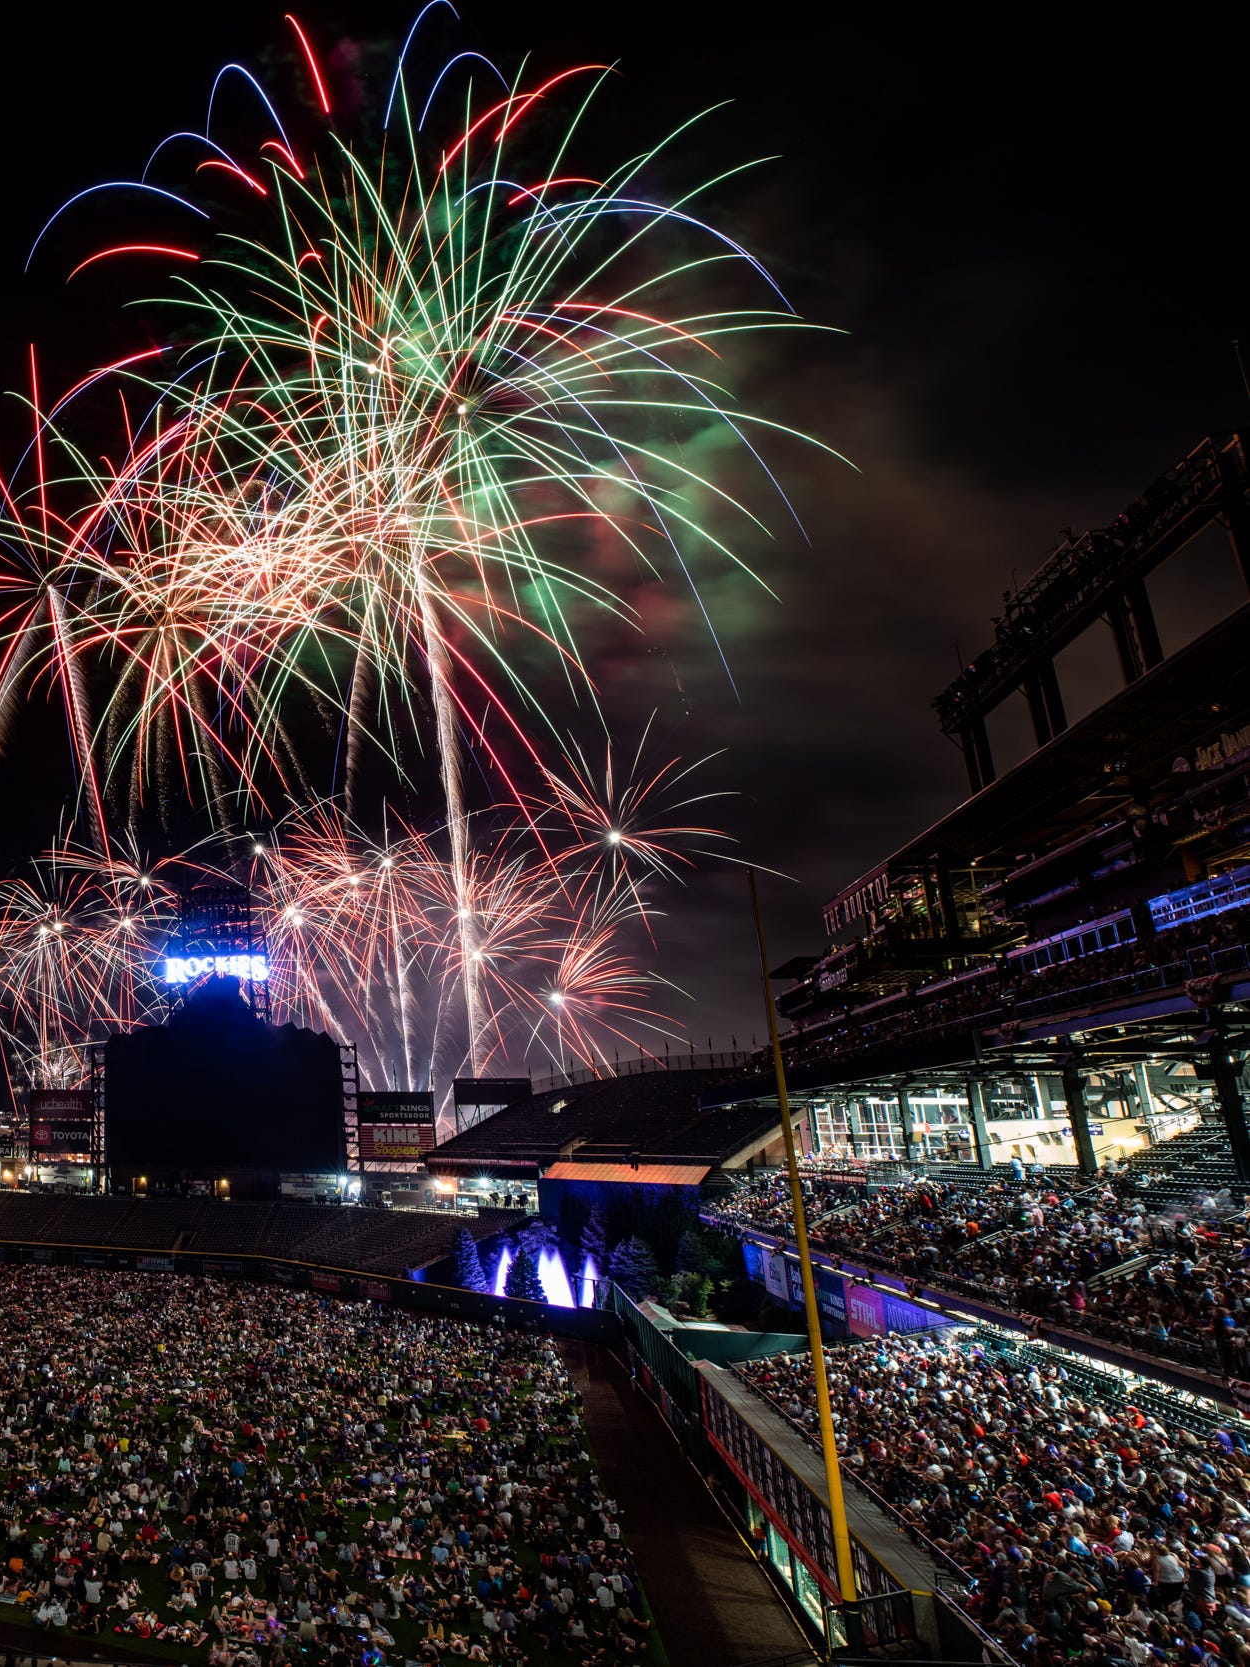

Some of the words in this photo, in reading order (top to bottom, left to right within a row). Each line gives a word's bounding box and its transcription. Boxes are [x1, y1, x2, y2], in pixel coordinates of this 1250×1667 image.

[824, 905, 843, 936] THE
[843, 873, 890, 925] ROOFTOP
[165, 955, 270, 983] ROCKIES
[40, 1097, 83, 1110] uchealth
[52, 1131, 89, 1140] TOYOTA
[373, 1128, 421, 1143] KING
[850, 1297, 881, 1331] STIHL
